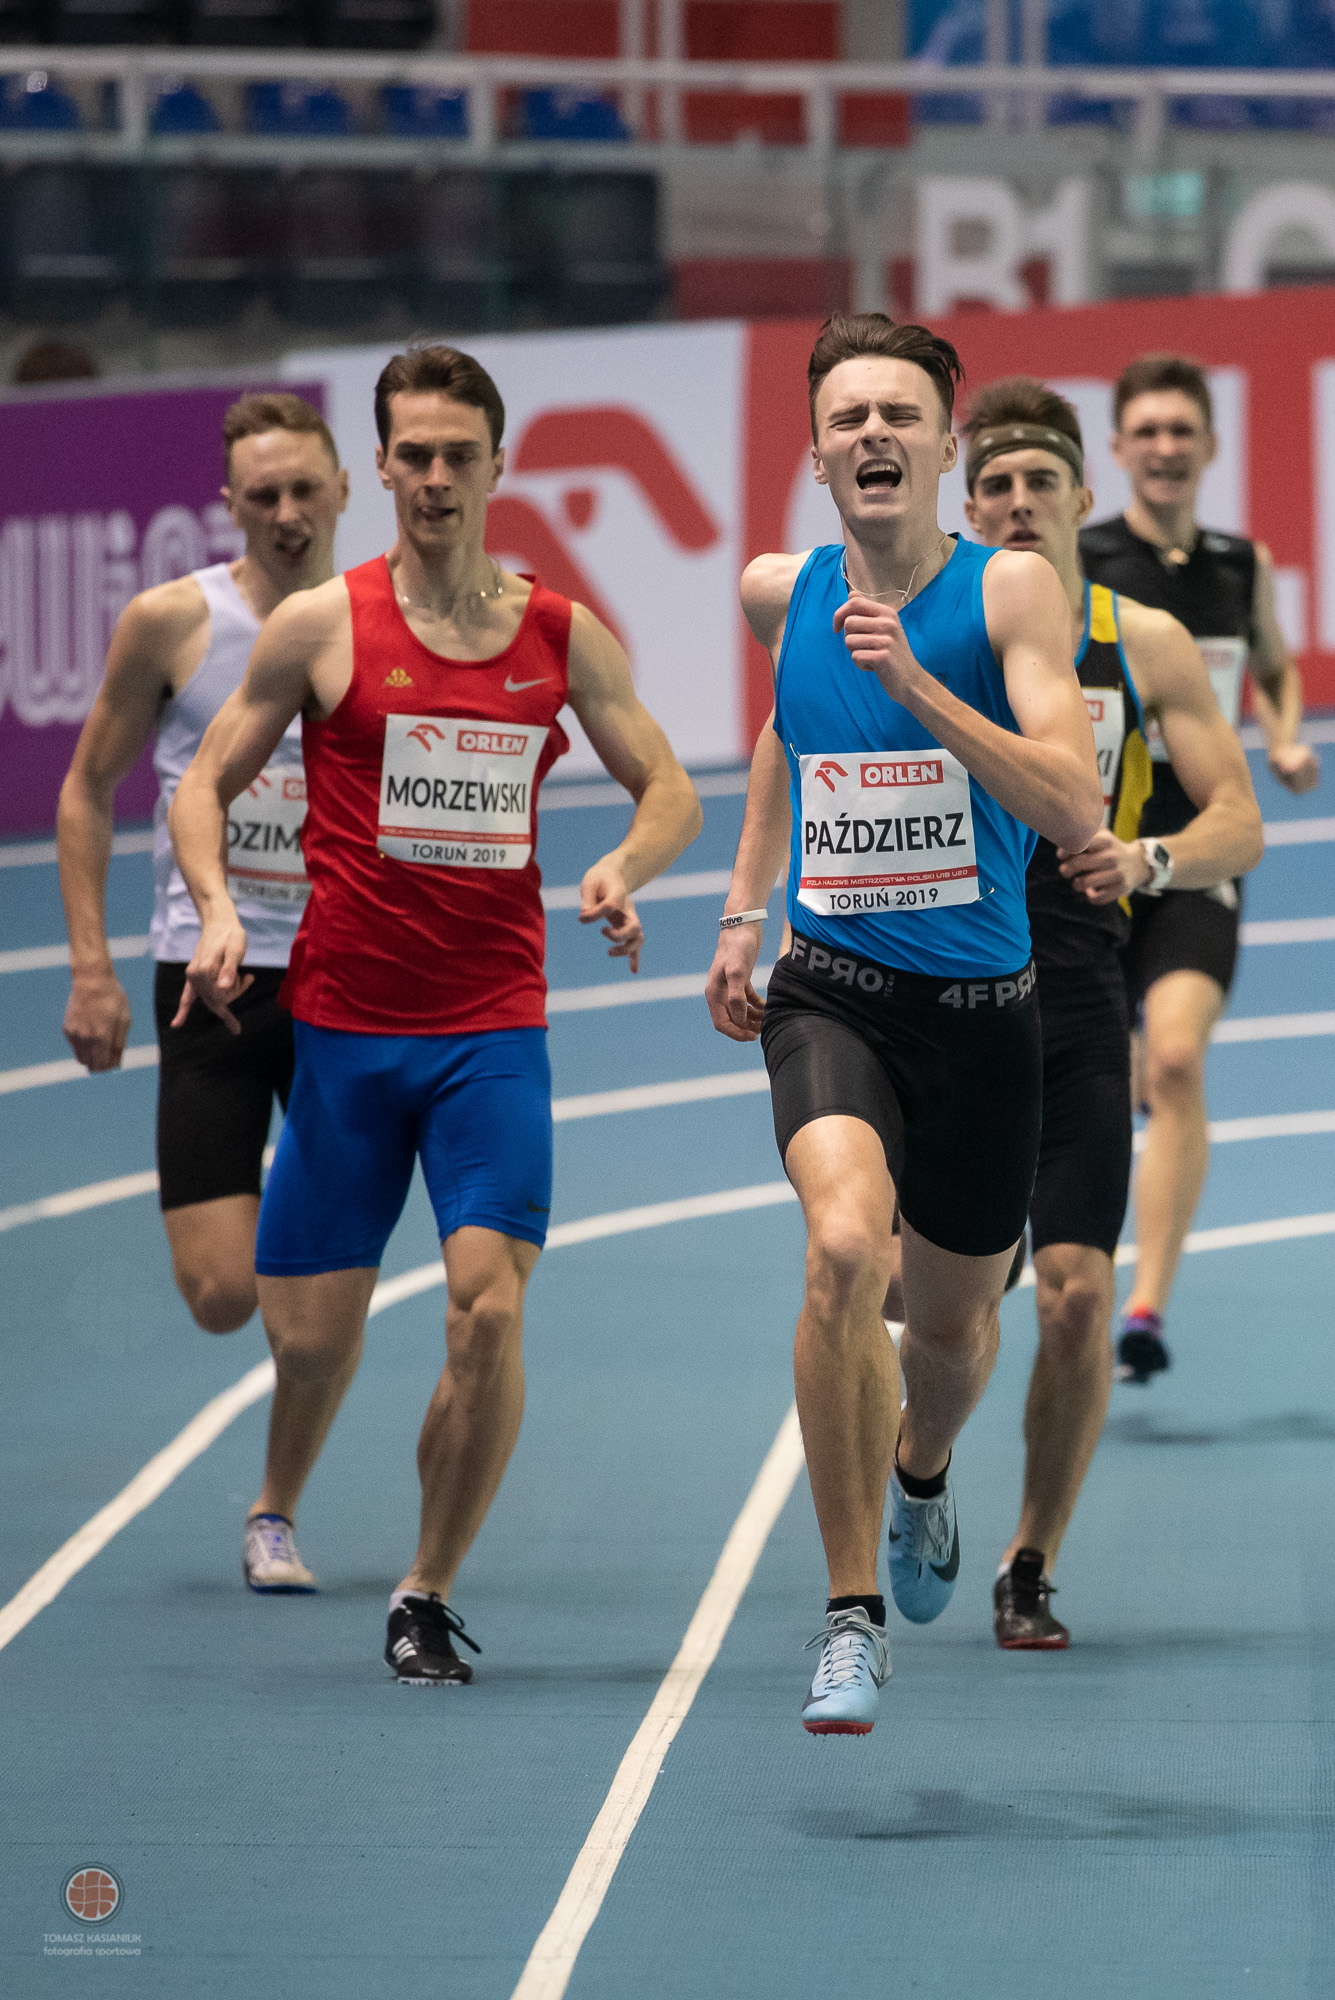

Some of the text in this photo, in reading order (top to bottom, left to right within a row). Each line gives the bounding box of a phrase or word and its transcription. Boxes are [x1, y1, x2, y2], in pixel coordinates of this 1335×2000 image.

[460, 732, 526, 753] ORLEN
[864, 763, 939, 785] ORLEN
[386, 775, 528, 813] MORZEWSKI
[805, 812, 967, 855] PAŹDZIERZ
[473, 848, 507, 862] 2019
[850, 876, 906, 885] MISTRZOSTWA
[907, 874, 935, 882] POLSKI
[951, 869, 968, 877] U20
[830, 887, 938, 910] TORUŃ 2019
